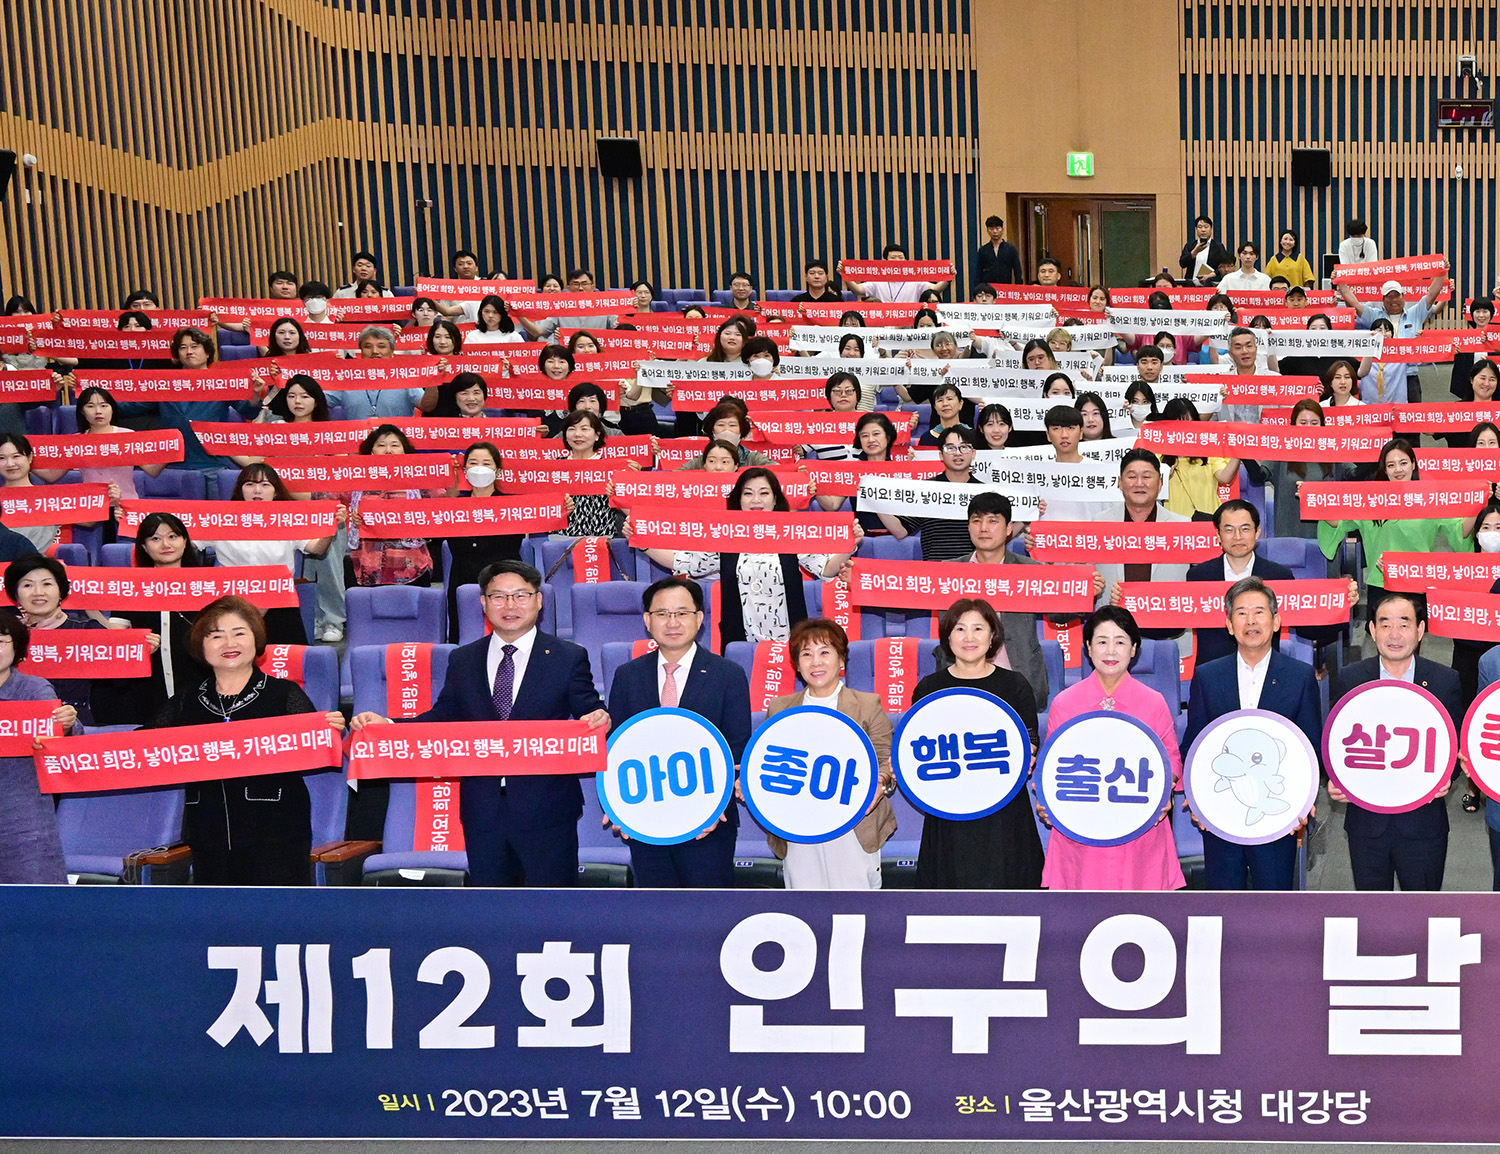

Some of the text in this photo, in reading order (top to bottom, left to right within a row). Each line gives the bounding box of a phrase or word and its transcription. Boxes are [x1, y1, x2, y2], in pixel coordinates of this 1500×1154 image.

[1398, 411, 1426, 423] 품어요!
[1426, 411, 1446, 424] 희망,
[1446, 411, 1474, 424] 낳아요!
[1475, 410, 1494, 423] 행복,
[1306, 490, 1485, 508] 품어요! 희망, 낳아요! 행복, 키워요! 미래
[635, 519, 849, 541] 품어요! 희망, 낳아요! 행복, 키워요! 미래
[67, 576, 296, 598] 어요! 희망, 낳아요! 행복, 키워요! 미래
[859, 573, 1088, 597] 품어요! 희망, 낳아요! 행복, 키워요! 미래
[1124, 592, 1345, 614] 품어요! 희망, 키워요! 미래
[29, 643, 144, 664] 행복, 키워요! 미래
[21, 717, 55, 738] 미래
[43, 753, 100, 774] 품어요!
[101, 748, 142, 770] 희망,
[143, 744, 200, 768] 낳아요!
[201, 739, 241, 762] 행복,
[243, 733, 299, 757] 키워요!
[300, 725, 334, 751] 미래
[377, 739, 415, 760] 희망,
[416, 738, 470, 759] 낳아요!
[472, 738, 510, 759] 행복,
[512, 737, 564, 757] 키워요!
[567, 734, 598, 756] 미래
[910, 729, 1010, 781] 행복
[1342, 723, 1436, 773] 살기
[617, 747, 715, 805] 아이
[760, 743, 860, 806] 좋아
[1055, 755, 1153, 803] 출산
[207, 942, 631, 1053] 제12회
[720, 913, 1222, 1054] 인구의
[1323, 918, 1481, 1055] 날
[378, 1086, 911, 1122] 일시 2023년 7월 12일(수) 10:00
[955, 1089, 1370, 1124] 장소 울산광역시청 대강당
